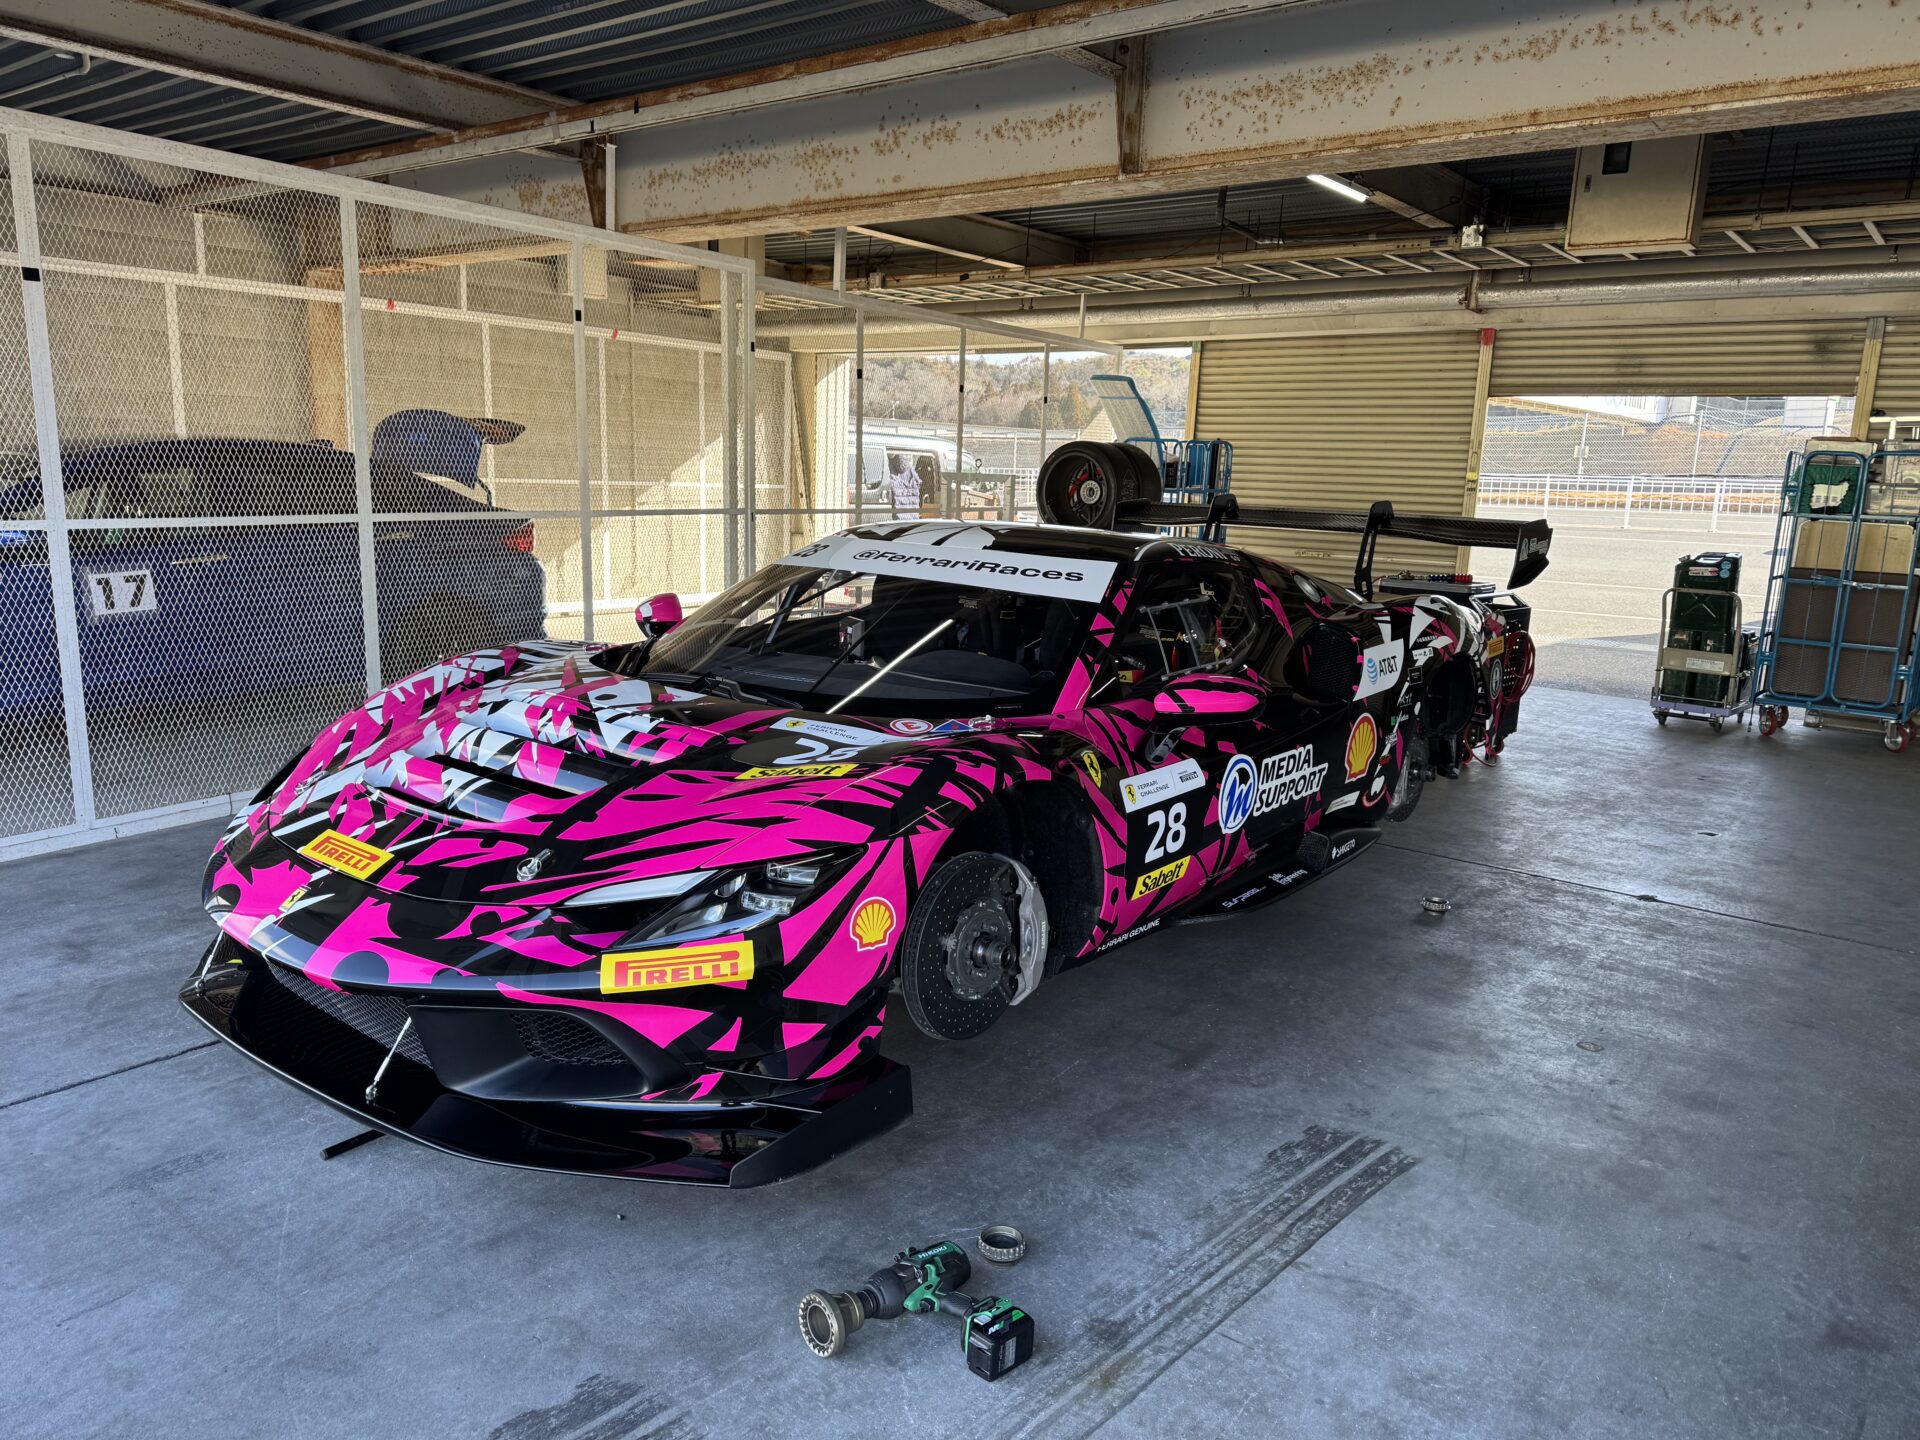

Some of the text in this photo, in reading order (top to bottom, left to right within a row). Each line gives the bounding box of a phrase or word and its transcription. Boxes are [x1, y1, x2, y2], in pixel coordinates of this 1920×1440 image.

[792, 543, 830, 558] 28
[1166, 542, 1229, 560] PERONI
[852, 548, 1085, 583] @FerrariRaces
[96, 573, 147, 610] 17
[1378, 655, 1398, 677] AT&T
[806, 726, 859, 741] CHALLENGE
[809, 723, 848, 733] FERRARI
[901, 721, 923, 731] E
[750, 765, 843, 778] Sabelt
[1259, 747, 1312, 785] MEDIA
[1136, 779, 1159, 791] FERRARI
[1179, 771, 1199, 783] PIRELLI
[1140, 783, 1170, 797] CHALLENGE
[1254, 766, 1327, 814] SUPPORT
[1144, 801, 1187, 864] 28
[310, 835, 381, 872] PIRELLI
[1138, 861, 1184, 895] Sabelt
[1129, 917, 1161, 938] GENUINE
[614, 950, 740, 988] PIRELLI
[917, 1245, 948, 1259] HiKOKI
